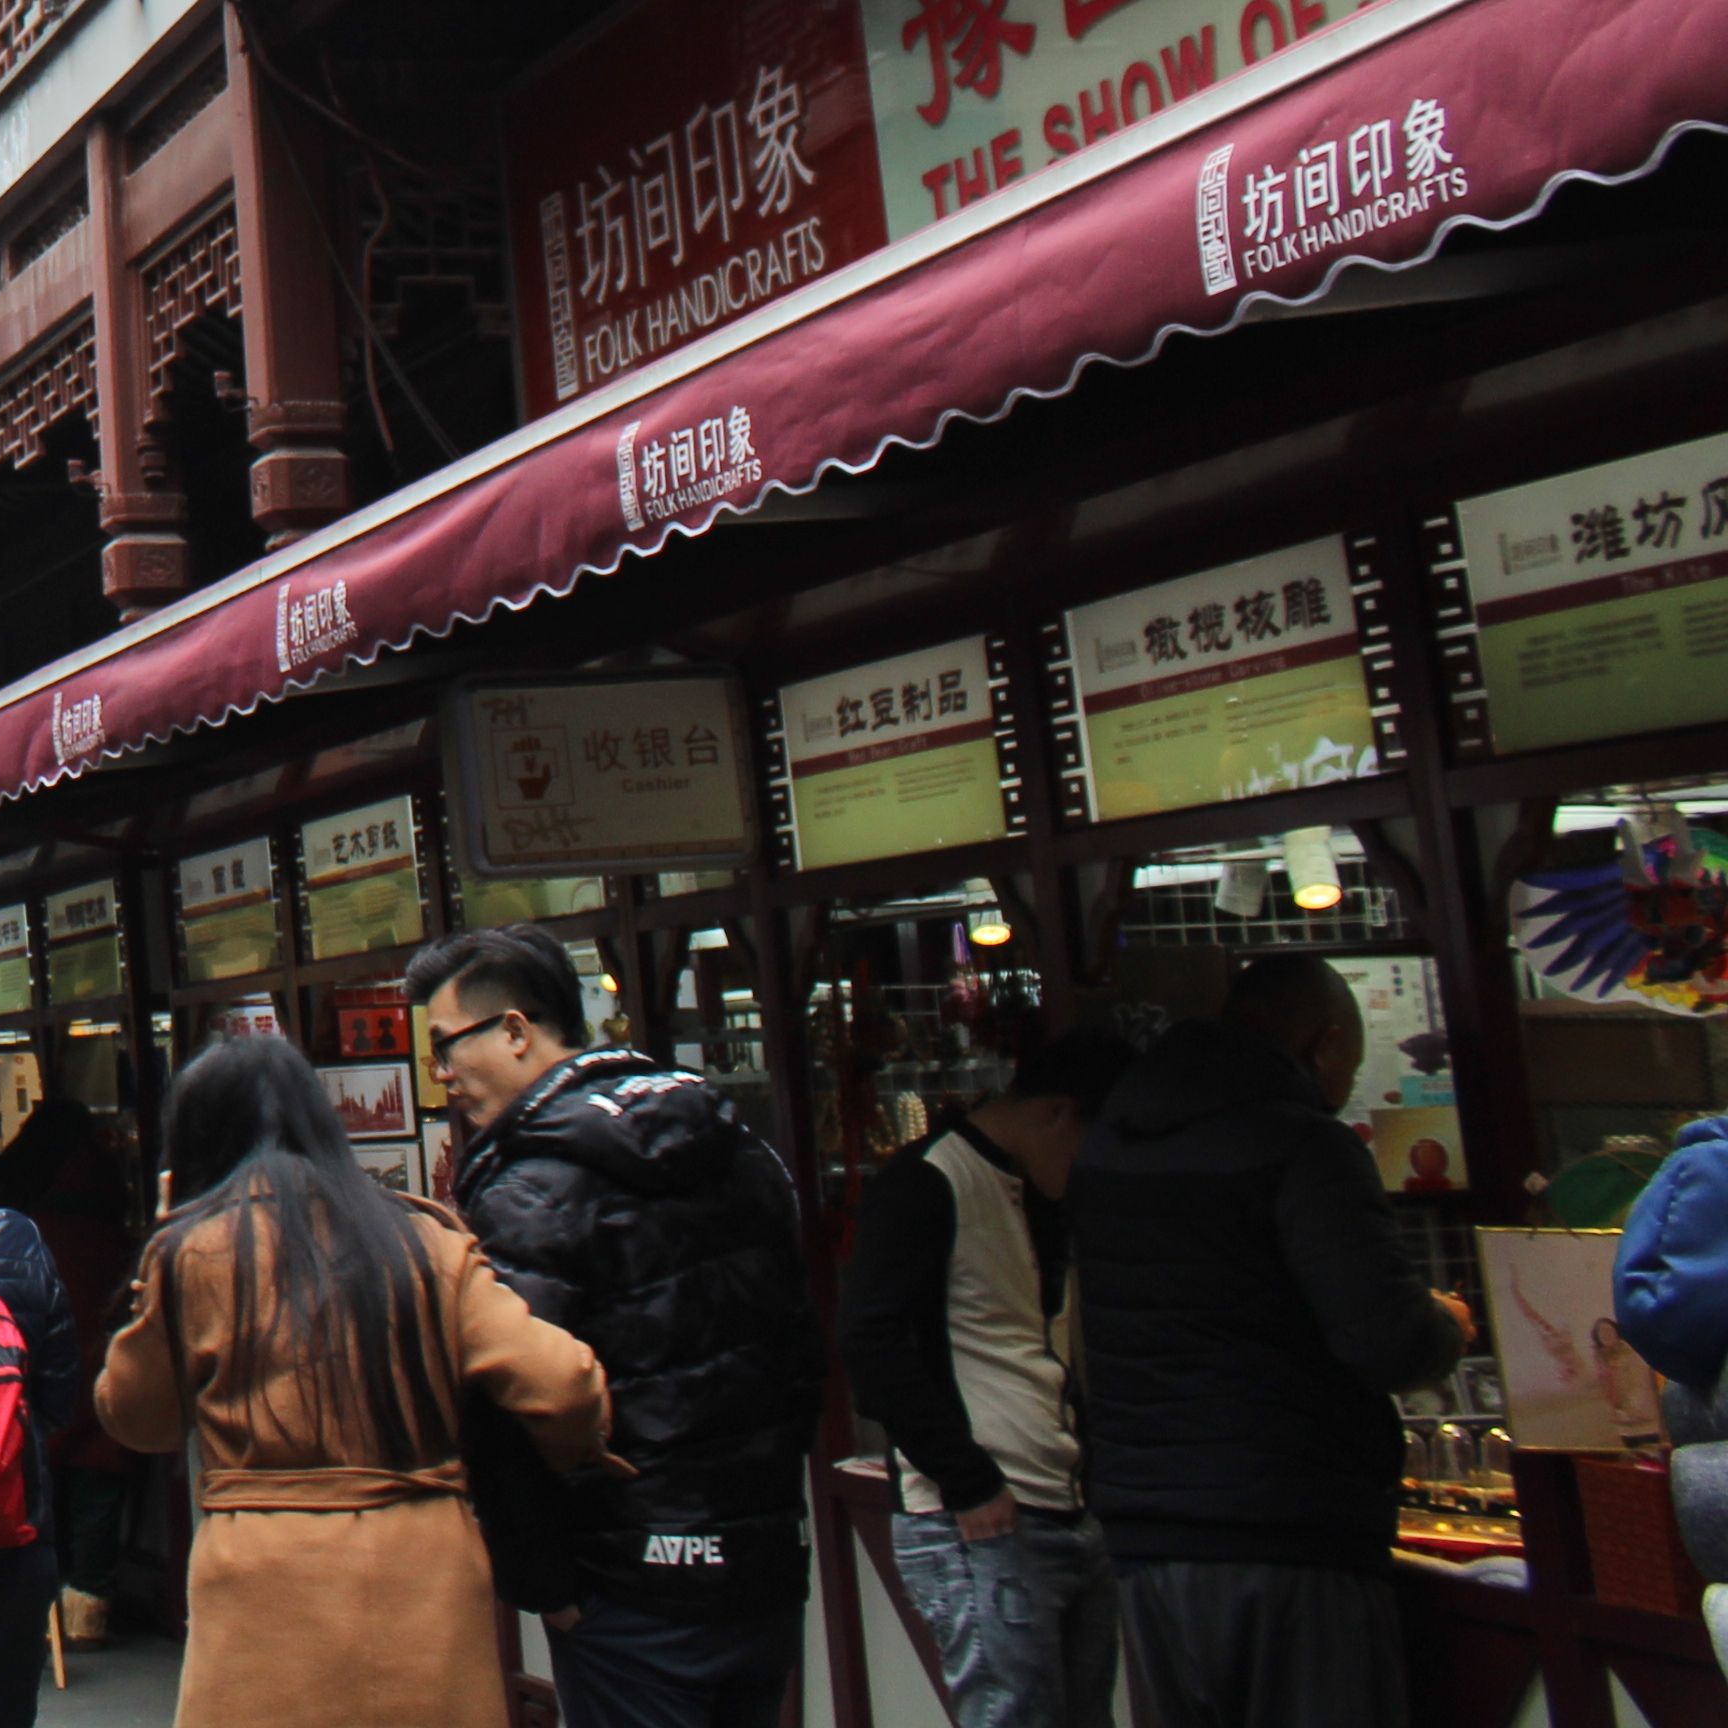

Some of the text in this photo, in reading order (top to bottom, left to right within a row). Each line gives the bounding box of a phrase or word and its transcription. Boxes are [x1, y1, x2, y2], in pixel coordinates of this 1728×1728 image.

[575, 64, 817, 306] 坊间印象
[1241, 98, 1453, 243] 坊间印象
[1242, 233, 1301, 279] FOLK
[1301, 167, 1468, 255] HANDICRAFTS
[583, 309, 643, 383] FOLK
[646, 215, 826, 353] HANDICRAFTS
[640, 405, 756, 499] 坊间印象
[644, 458, 763, 522] FOLK HANDICRAFTS
[584, 724, 720, 772] 收银台
[836, 669, 968, 738] 红豆制品
[621, 775, 691, 794] Cashier
